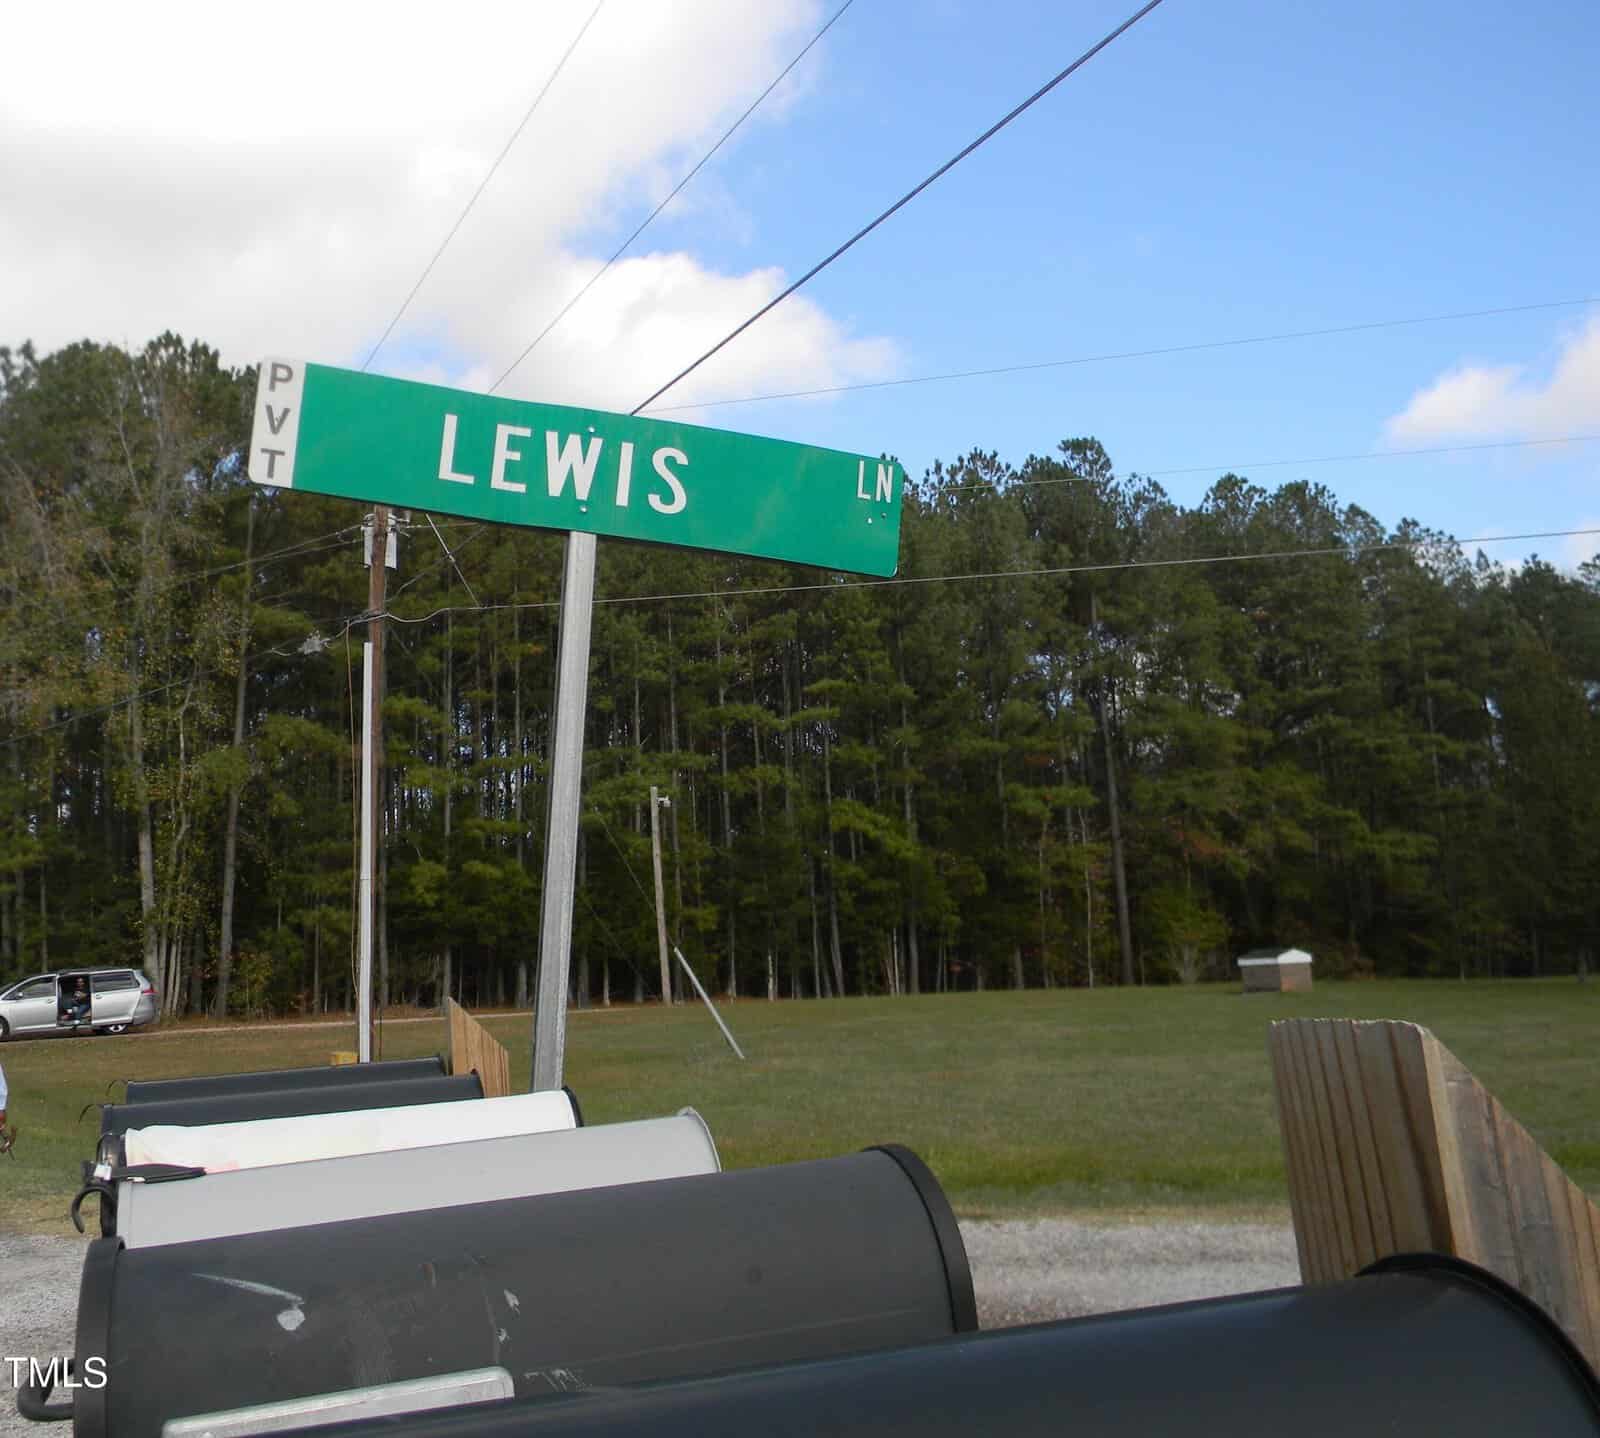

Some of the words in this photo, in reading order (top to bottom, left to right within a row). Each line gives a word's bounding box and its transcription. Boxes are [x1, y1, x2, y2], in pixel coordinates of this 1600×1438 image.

[260, 362, 294, 479] PVT
[438, 413, 689, 514] LEWIS
[857, 460, 893, 503] LN
